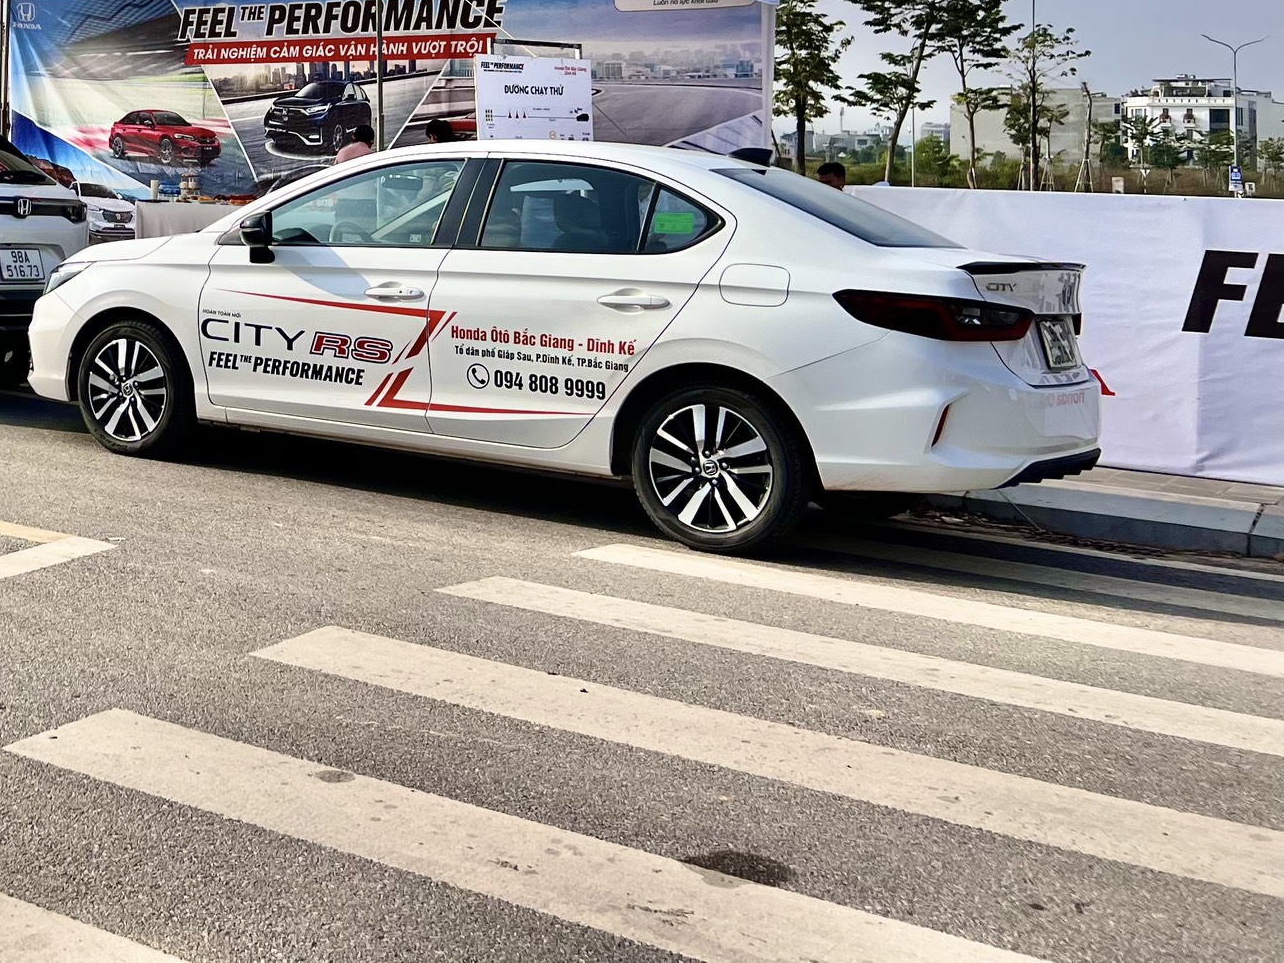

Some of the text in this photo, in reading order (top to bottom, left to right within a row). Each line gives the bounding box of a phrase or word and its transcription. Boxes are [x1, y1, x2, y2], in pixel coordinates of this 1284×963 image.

[13, 22, 42, 30] HONDA
[179, 6, 237, 40] FEEL
[240, 5, 265, 21] THE
[193, 44, 216, 60] TRẢI
[220, 45, 267, 62] NGHIỆM
[270, 42, 299, 57] CẢM
[302, 41, 335, 57] GIÁC
[339, 41, 366, 60] VẬN
[412, 39, 447, 58] VƯỢT
[450, 37, 483, 57] TRỘI
[504, 83, 529, 95] ĐƯỜNG
[530, 86, 548, 96] CHẠY
[11, 251, 30, 263] 98A
[6, 265, 40, 277] 516.73
[986, 282, 1017, 292] CITY
[201, 318, 393, 364] CITY RS
[451, 325, 487, 342] Honda
[491, 326, 509, 344] Ôtô
[514, 328, 536, 347] Bắc
[540, 334, 574, 352] Giang
[587, 338, 615, 354] Dĩnh
[619, 339, 637, 356] Kế
[208, 351, 365, 386] FEEL THE PERFORMANCE
[466, 347, 480, 357] dân
[605, 360, 629, 373] Giang
[494, 370, 606, 400] 094 808 9999
